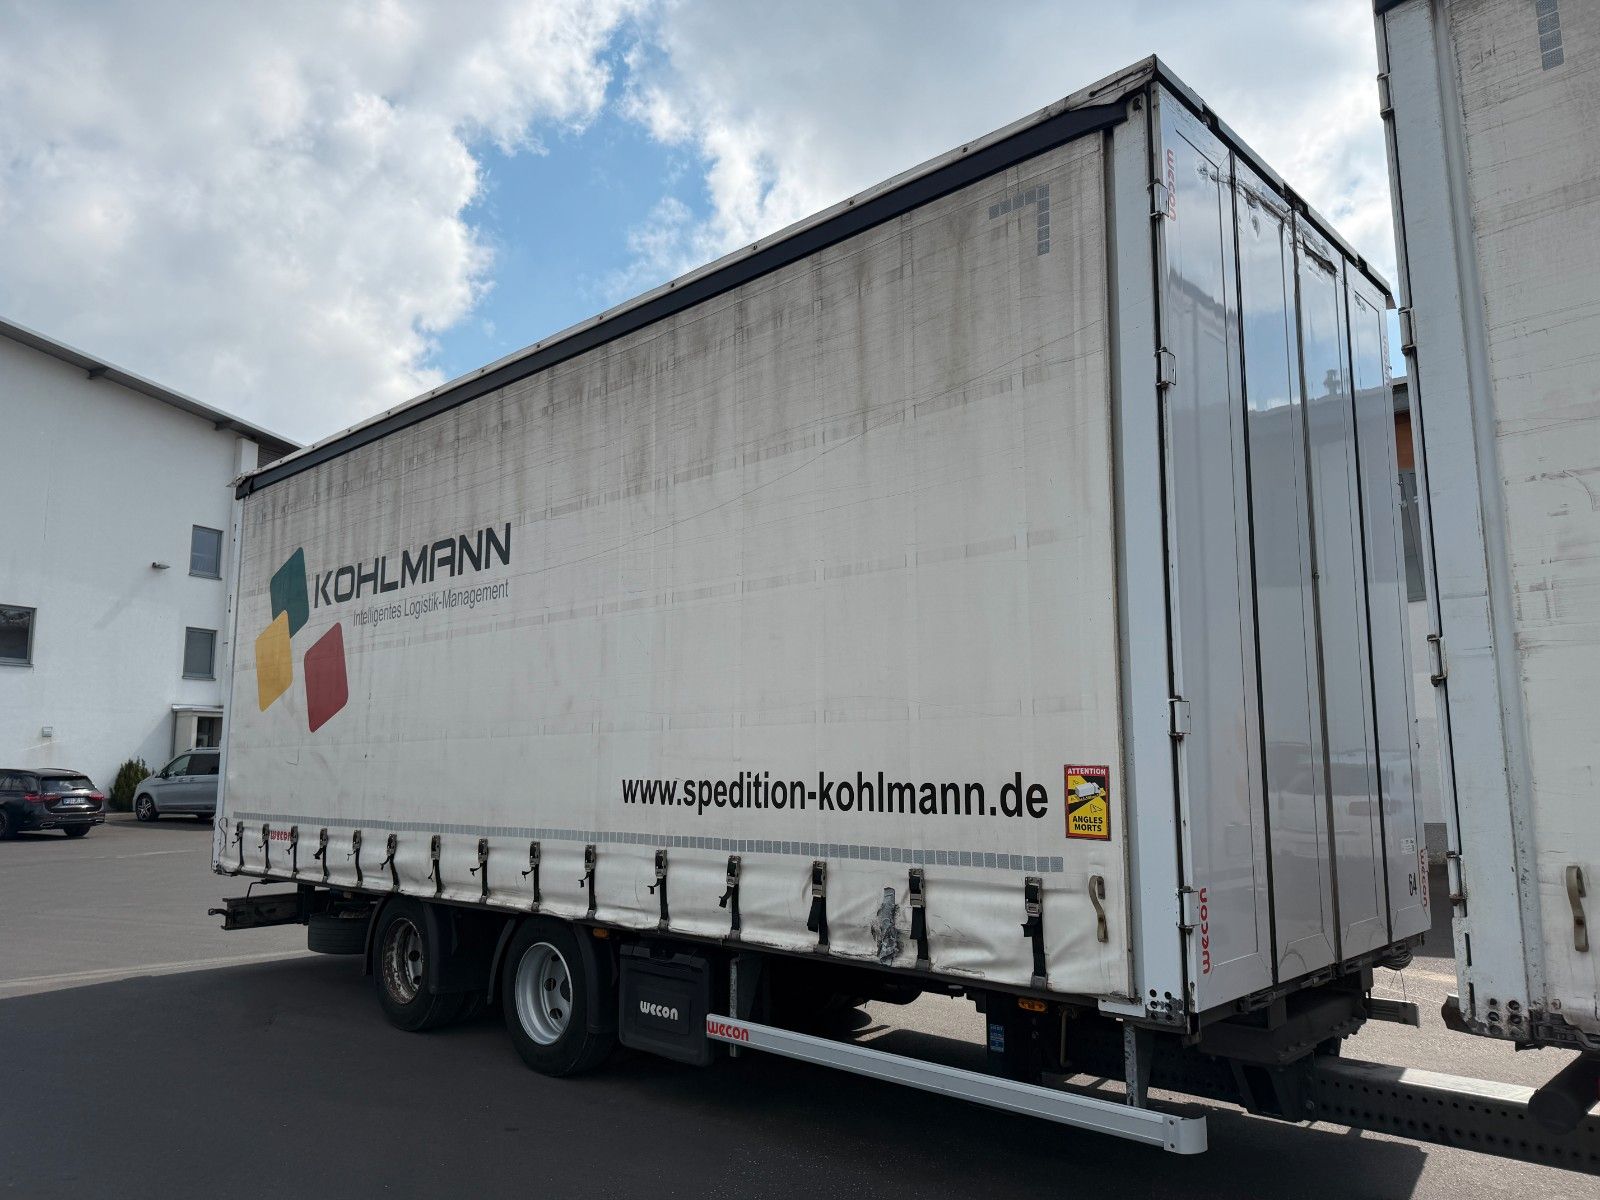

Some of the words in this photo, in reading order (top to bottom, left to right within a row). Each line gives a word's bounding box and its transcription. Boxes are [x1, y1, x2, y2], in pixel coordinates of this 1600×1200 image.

[314, 523, 511, 608] KOHLMANN
[353, 604, 401, 627] Intelligentes
[404, 580, 509, 619] Logistik-Management
[1067, 767, 1106, 776] ATTENTION
[621, 771, 1048, 818] www.spedition-kohlmann.de
[1072, 816, 1103, 824] ANGLES
[1074, 824, 1102, 832] MORTS
[1199, 888, 1211, 975] wecon
[640, 1000, 679, 1021] wecon
[706, 1020, 749, 1041] wecon
